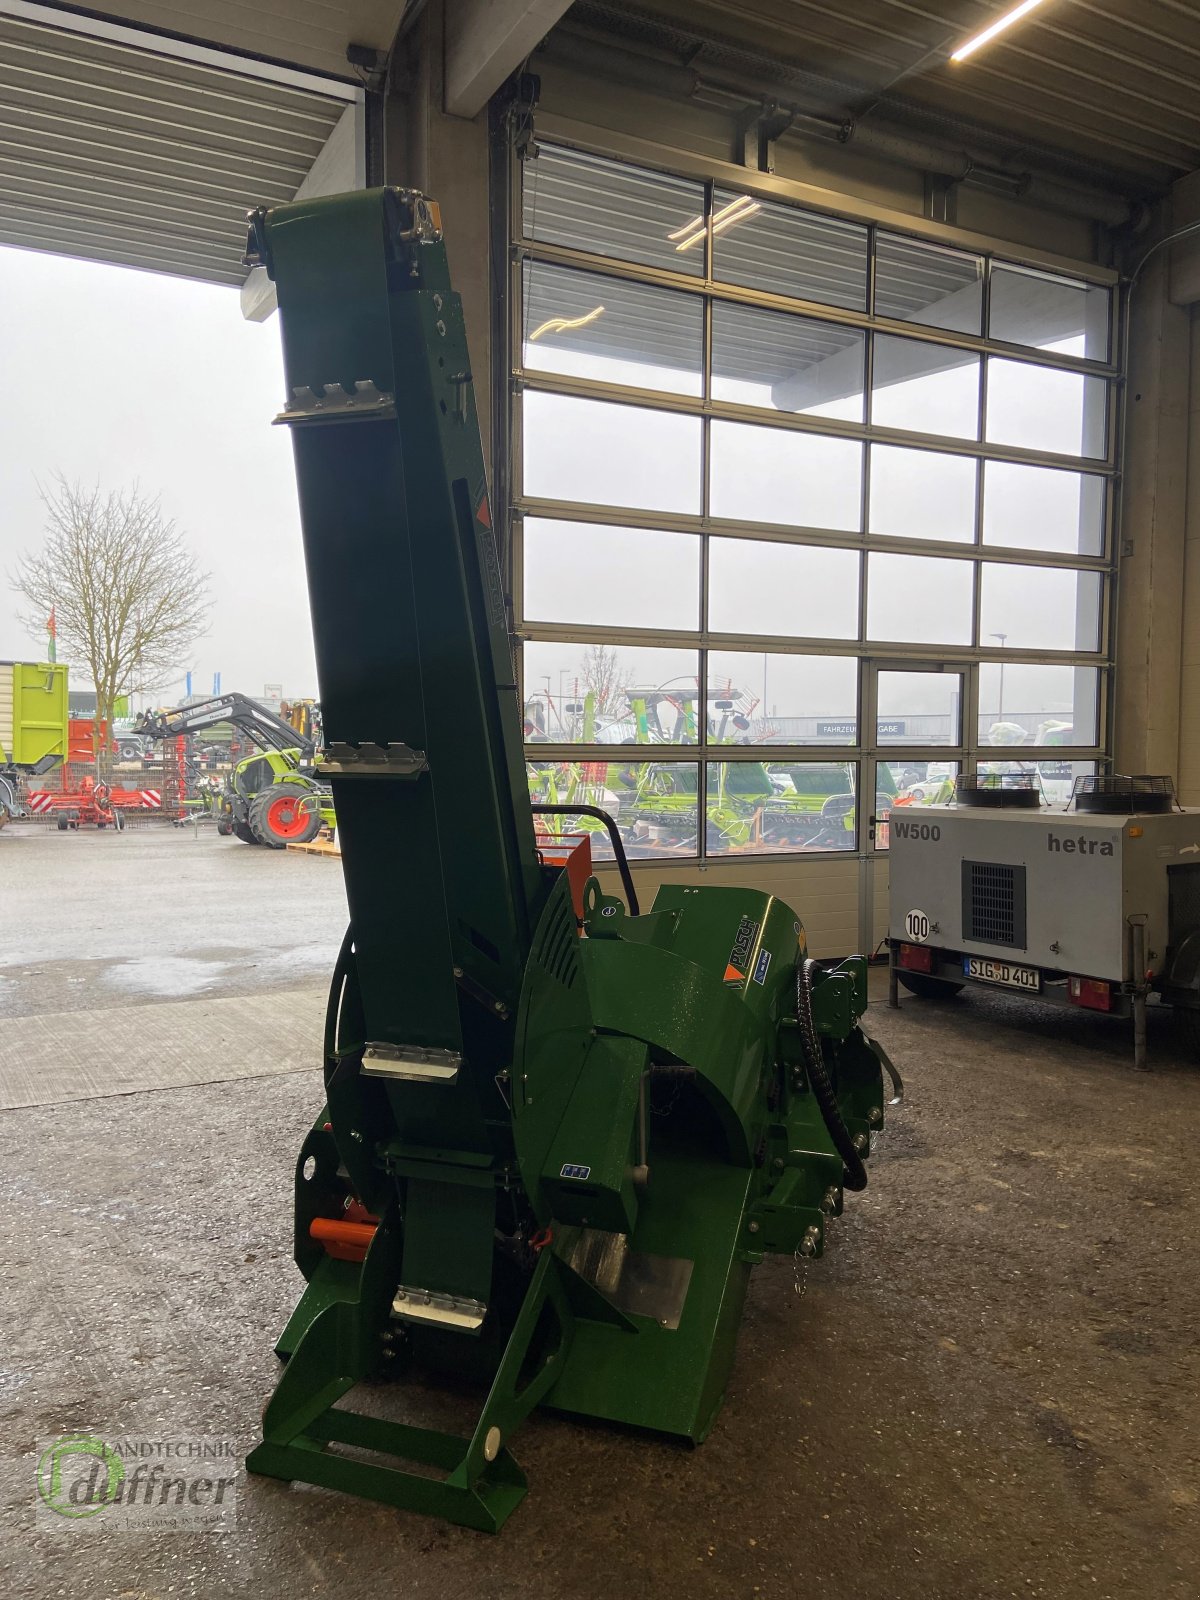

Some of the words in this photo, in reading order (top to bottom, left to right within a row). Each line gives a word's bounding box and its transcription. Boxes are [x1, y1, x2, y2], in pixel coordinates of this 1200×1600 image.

[878, 725, 898, 733] GABE
[894, 822, 941, 842] W500
[1047, 833, 1114, 857] hetra
[907, 913, 928, 938] 100
[728, 918, 758, 968] POSCH
[970, 959, 994, 979] SIG
[1002, 966, 1010, 982] D
[1013, 968, 1038, 988] 401
